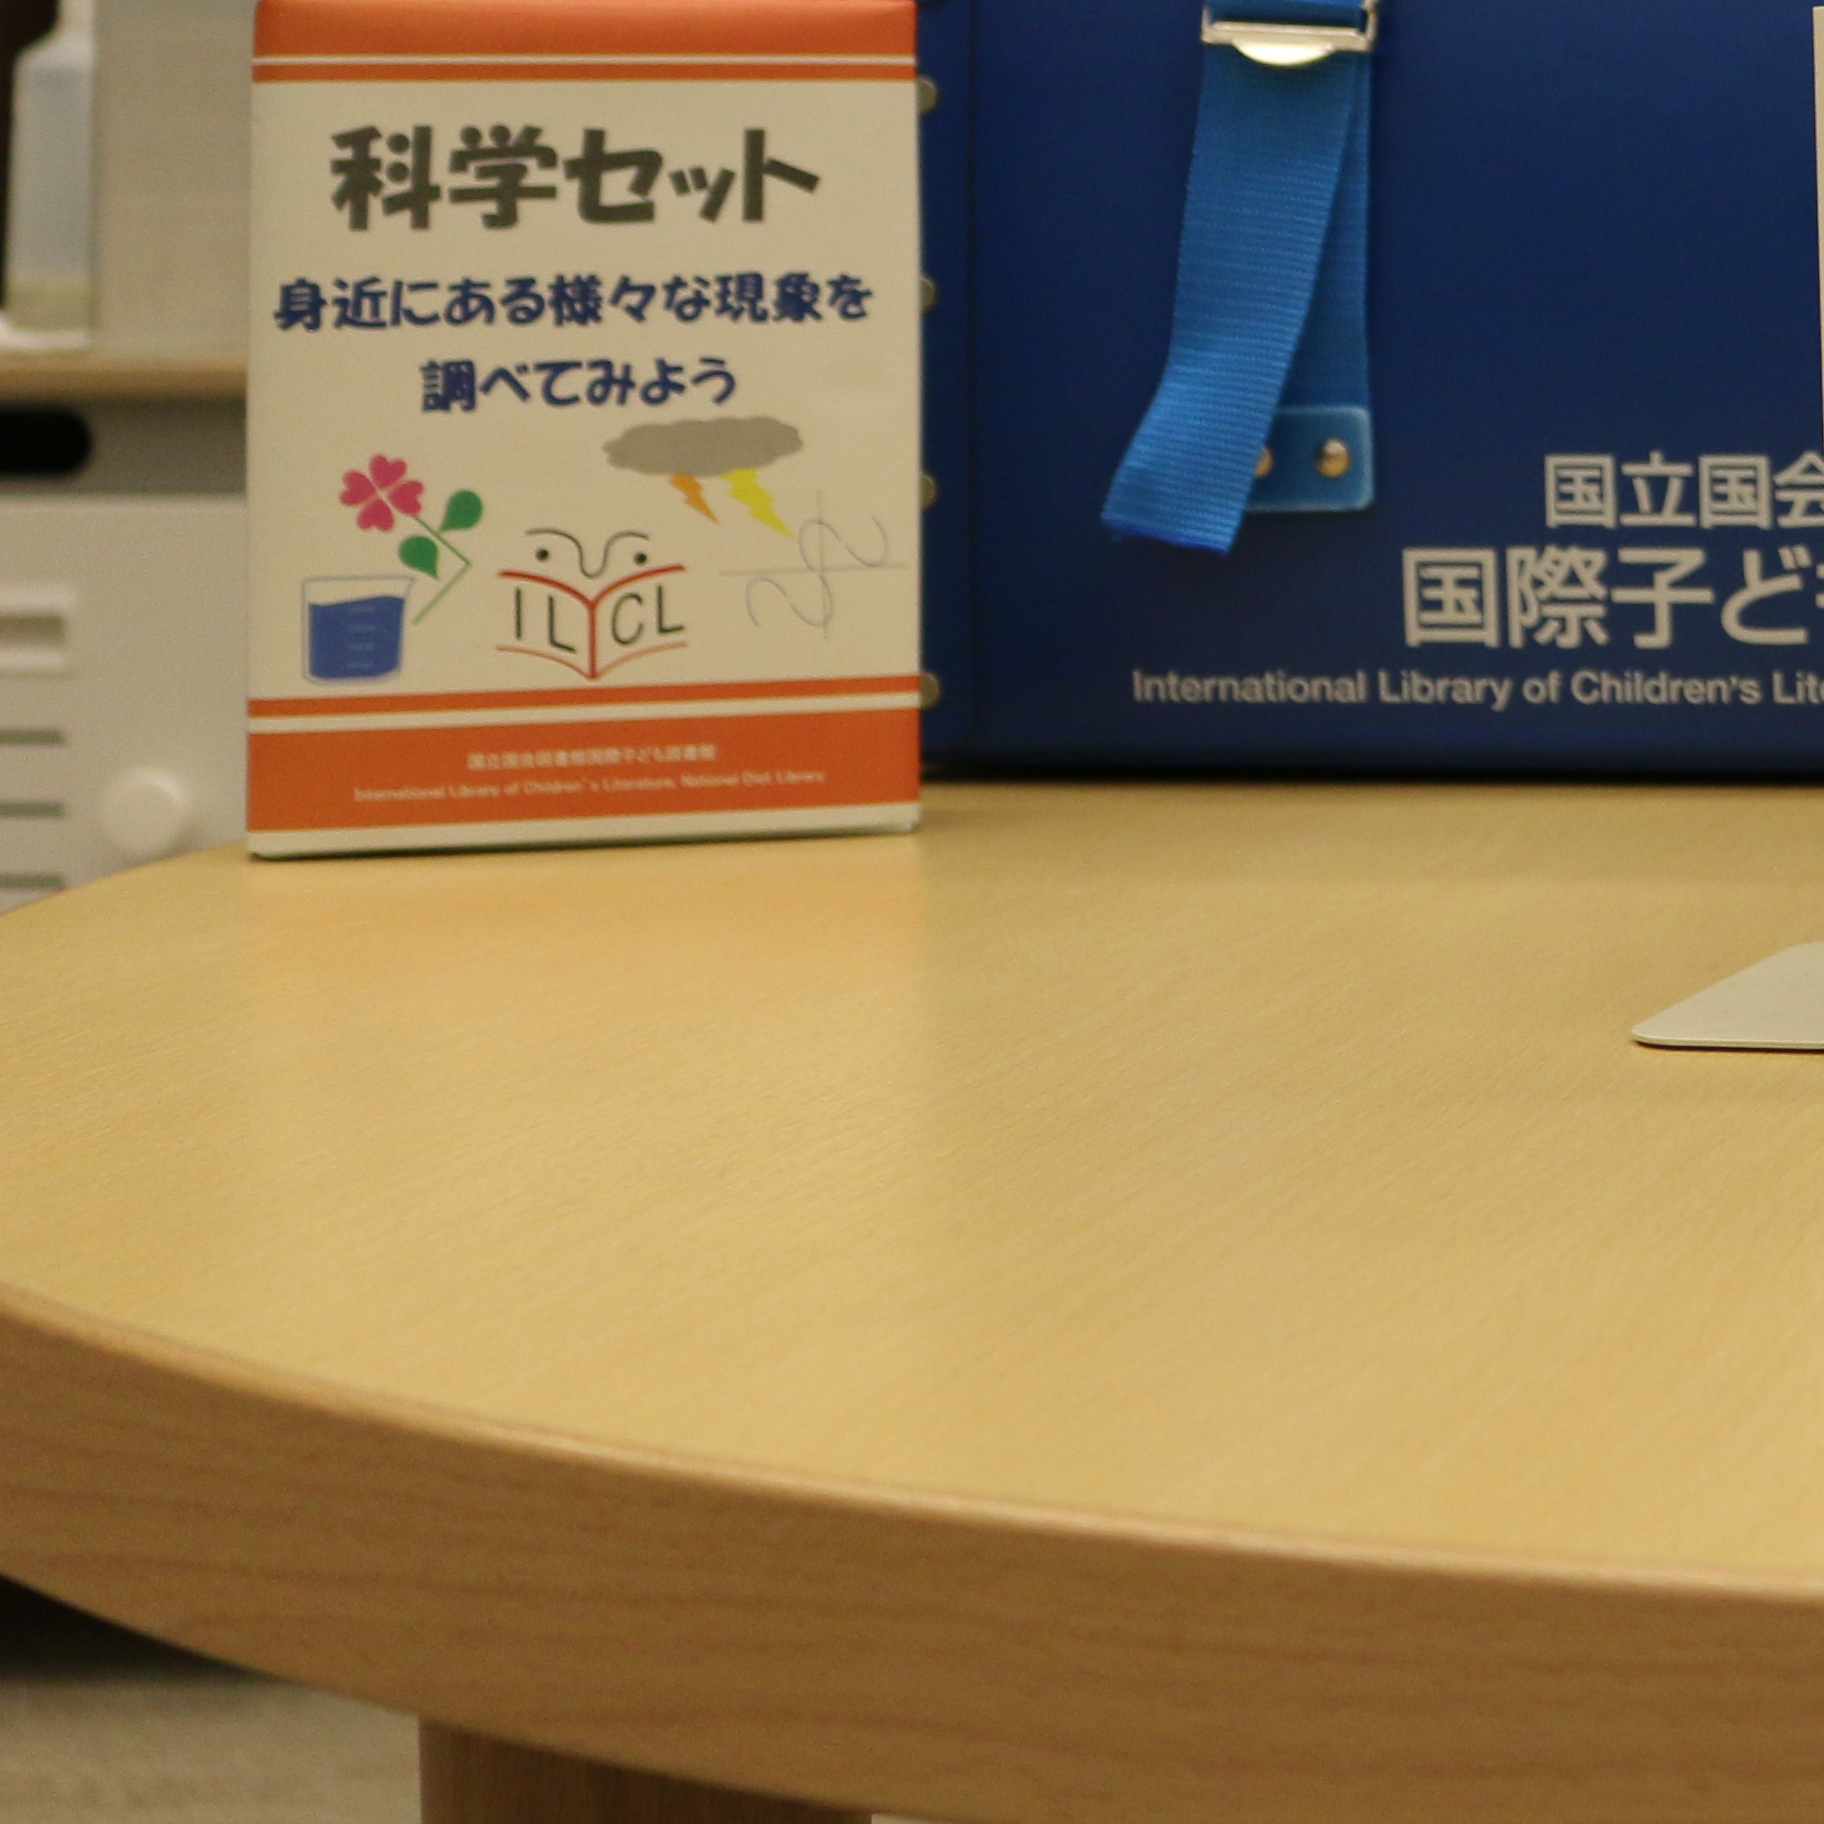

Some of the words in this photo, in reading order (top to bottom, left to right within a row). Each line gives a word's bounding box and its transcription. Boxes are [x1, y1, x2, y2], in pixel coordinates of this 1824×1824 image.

[329, 124, 820, 232] 科学セット
[273, 272, 876, 333] 身近にある様々な現象を
[420, 359, 739, 413] 調べてみよう
[1134, 671, 1366, 704] International
[1379, 674, 1512, 710] Library
[1522, 674, 1561, 704] of
[1570, 674, 1759, 705] Children's
